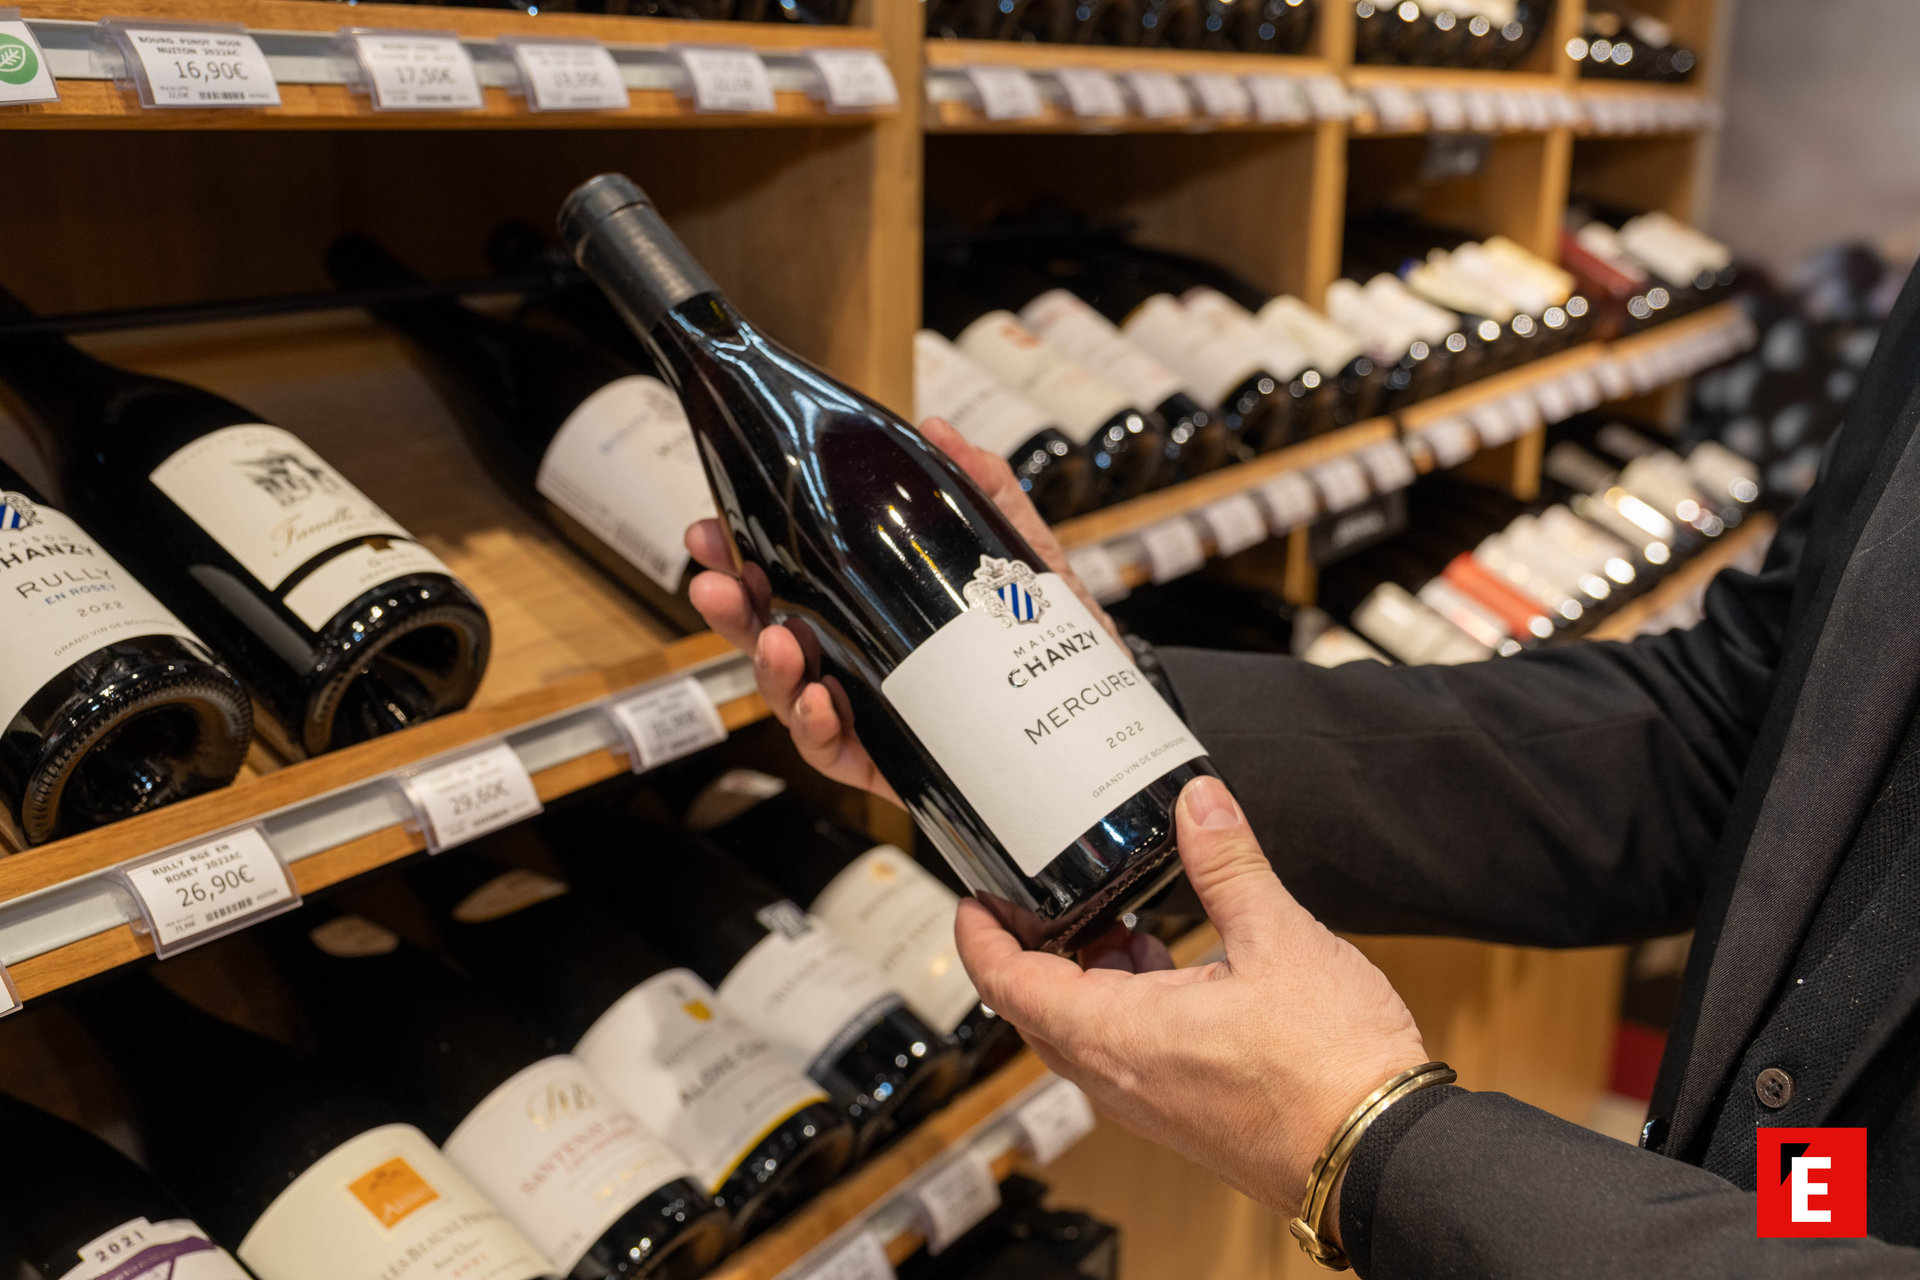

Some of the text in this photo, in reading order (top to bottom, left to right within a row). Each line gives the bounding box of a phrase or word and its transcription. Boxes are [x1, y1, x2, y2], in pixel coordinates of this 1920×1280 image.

[179, 37, 210, 47] PINOT
[174, 60, 248, 83] 16,90€
[0, 534, 69, 553] AISON
[0, 543, 94, 573] HANZY
[16, 568, 112, 599] RULLY
[44, 593, 67, 606] EN
[77, 601, 125, 618] 2022
[54, 634, 90, 656] GRAND
[90, 627, 108, 637] VIN
[1012, 620, 1076, 659] MAISON
[1007, 629, 1100, 688] CHANZY
[1023, 668, 1140, 746] MERCUREY
[1106, 720, 1144, 749] 2022
[1092, 771, 1124, 798] GRAND
[1123, 761, 1140, 775] VIN
[1139, 753, 1151, 765] DE
[151, 843, 231, 877] RULLY RGE EN
[165, 866, 199, 884] ROSEY
[175, 863, 256, 908] 26,90€
[95, 1229, 146, 1262] 2021
